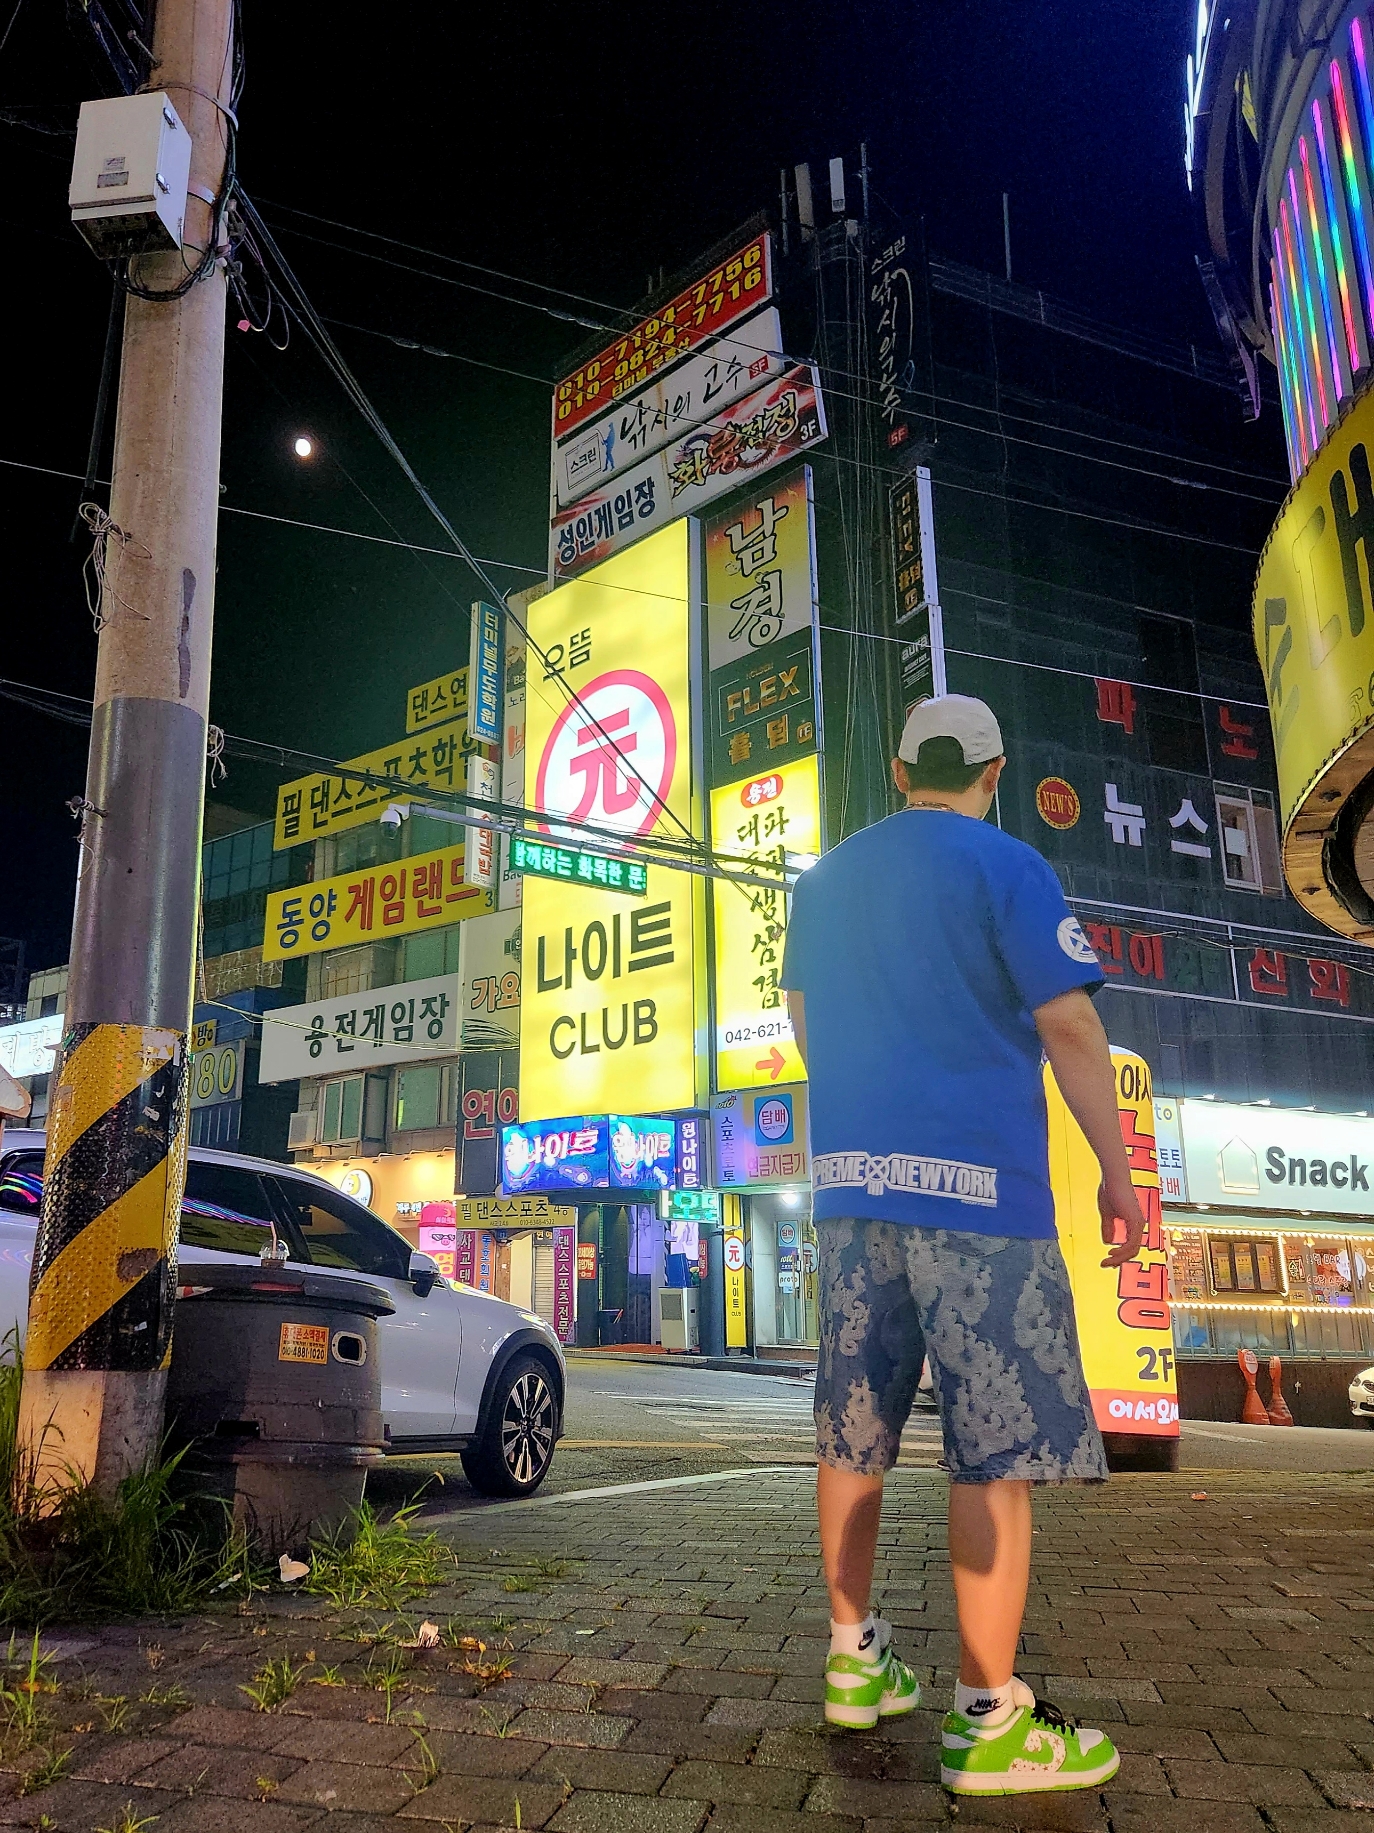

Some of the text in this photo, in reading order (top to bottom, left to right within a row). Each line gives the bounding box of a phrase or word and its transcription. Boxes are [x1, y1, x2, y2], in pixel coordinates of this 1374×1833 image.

[871, 235, 906, 274] 스크린
[558, 267, 762, 420] 010-9824-7716
[559, 246, 762, 400] 010-7194-7756
[611, 364, 648, 399] 터미널
[800, 420, 818, 442] 3F
[571, 447, 597, 470] 스크린
[557, 477, 656, 565] 성인게임장
[724, 497, 789, 648] 남경
[543, 627, 592, 682] 으뜸
[901, 633, 928, 662] aura
[727, 665, 800, 723] FLEX
[569, 708, 641, 832] 元
[746, 777, 778, 805] 용전
[1040, 793, 1075, 814] NEW'S
[737, 806, 791, 847] 대파
[577, 853, 623, 886] 화목한
[628, 864, 646, 891] 문
[276, 888, 338, 949] 동양
[344, 856, 481, 930] 게임랜드
[537, 899, 675, 993] 나이트
[1248, 947, 1350, 1007] 신화
[304, 992, 450, 1058] 용전게임장
[549, 997, 659, 1060] CLUB
[761, 1108, 786, 1126] 담배
[681, 1121, 699, 1188] 원나이트
[720, 1116, 736, 1182] 스포츠토토
[747, 1152, 806, 1178] 현금지급기
[1265, 1146, 1371, 1192] Snack
[461, 1202, 472, 1221] 필
[477, 1200, 549, 1220] 댄스스포츠
[728, 1245, 740, 1263] 元
[557, 1235, 570, 1336] 댄스스포츠전문
[732, 1276, 740, 1309] 나이트
[1137, 1344, 1175, 1384] 2F
[974, 1697, 1001, 1710] NIKE
